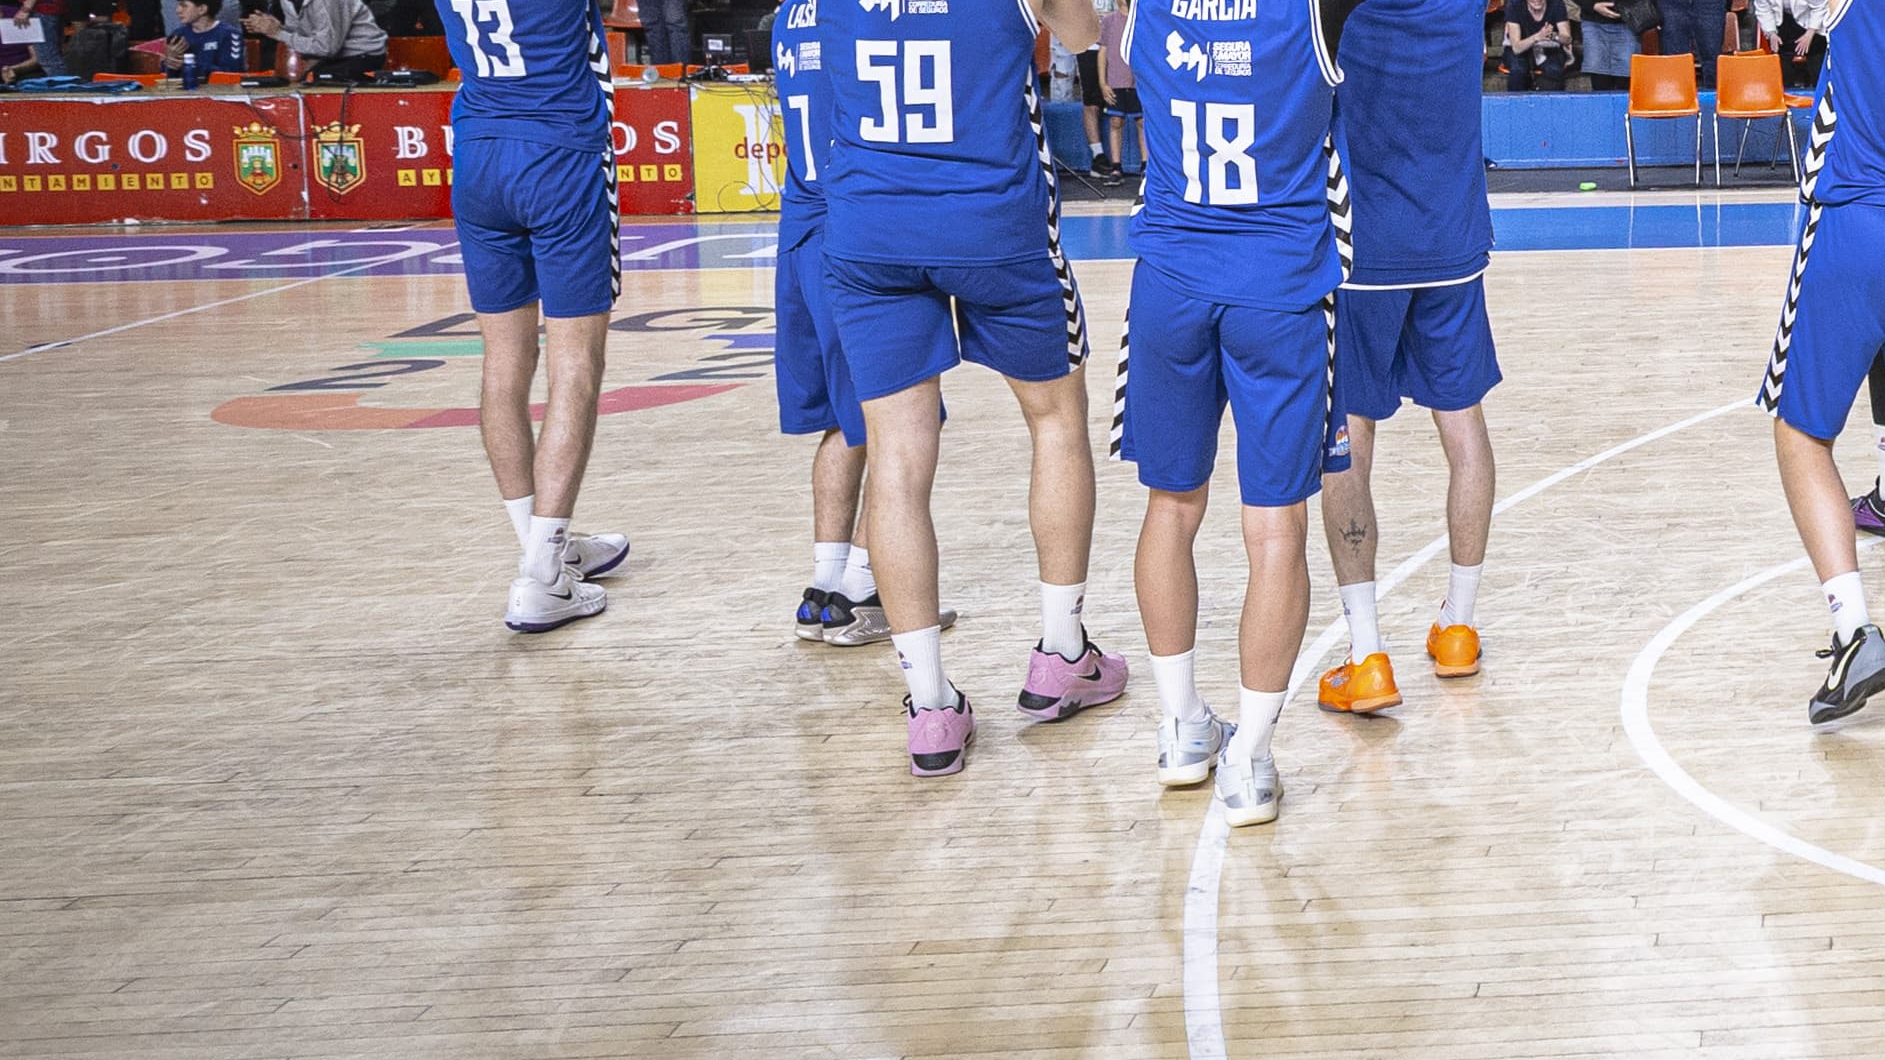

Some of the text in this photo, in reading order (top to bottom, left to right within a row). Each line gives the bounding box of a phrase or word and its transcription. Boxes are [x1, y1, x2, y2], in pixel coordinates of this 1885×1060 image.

[856, 40, 953, 143] 59
[0, 129, 213, 164] RGOS
[1170, 99, 1259, 205] 18
